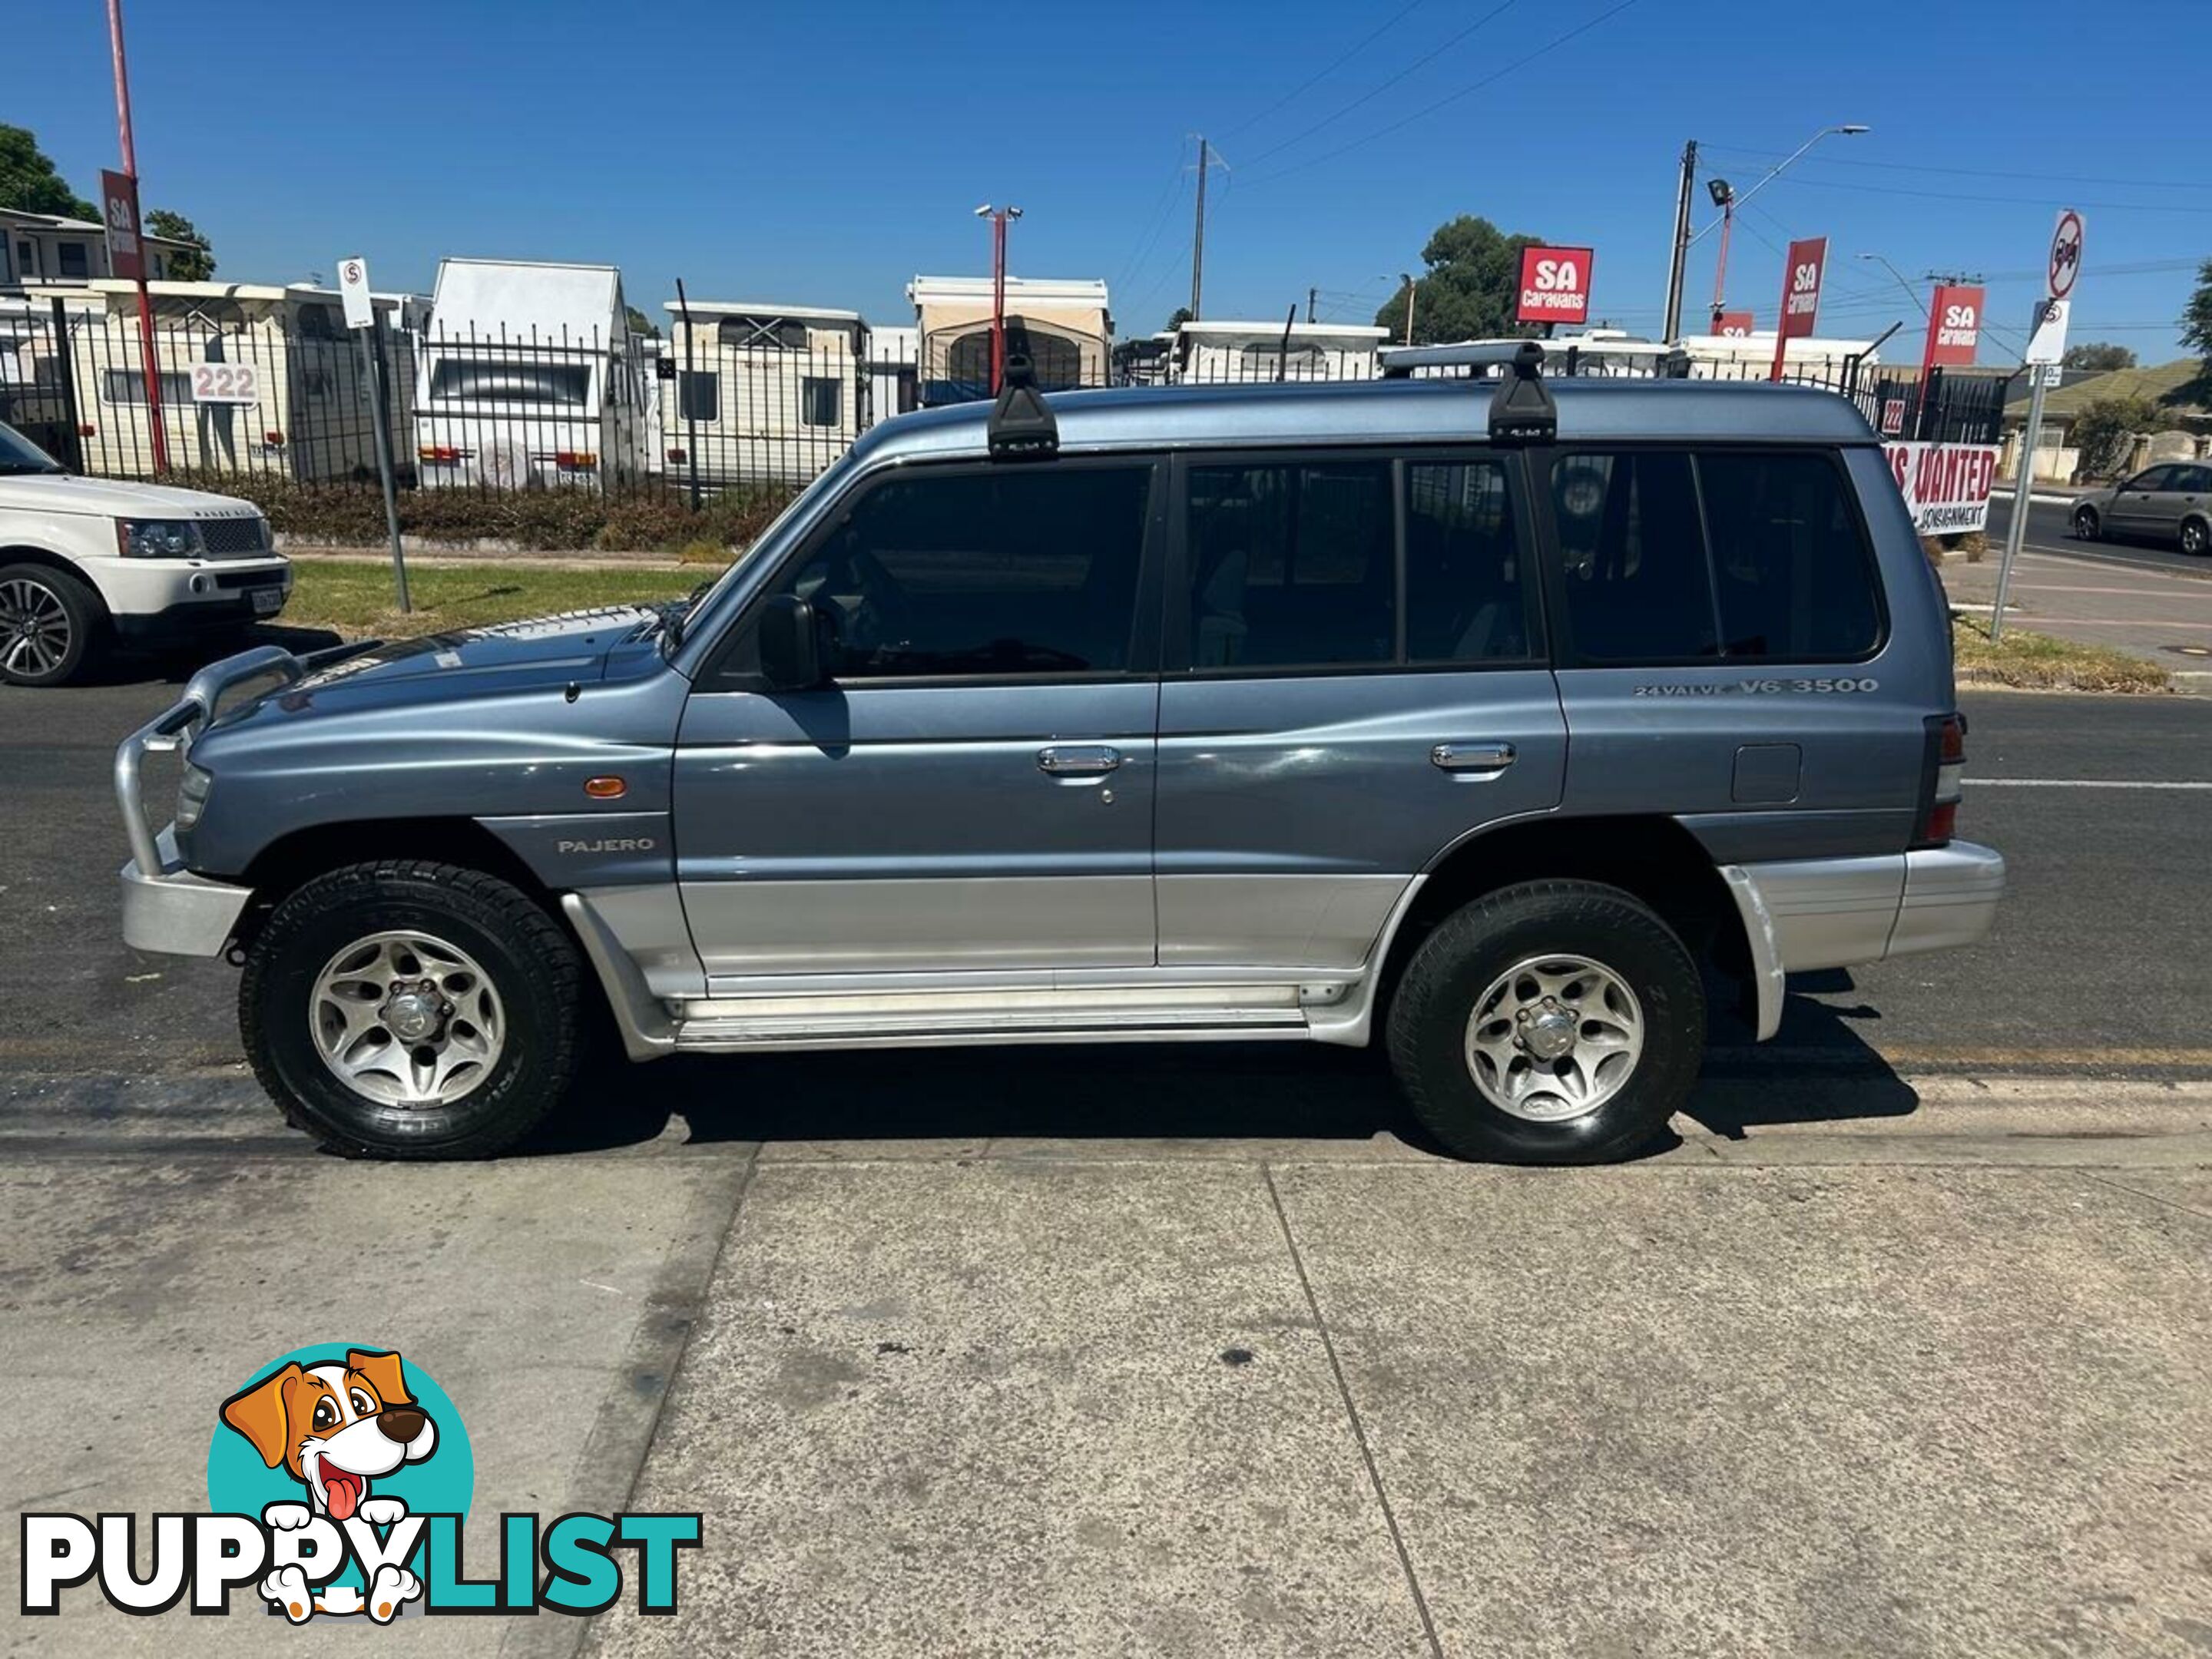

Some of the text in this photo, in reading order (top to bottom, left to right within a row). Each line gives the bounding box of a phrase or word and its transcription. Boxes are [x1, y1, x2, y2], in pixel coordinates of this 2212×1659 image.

[110, 197, 132, 229] SA
[1536, 260, 1577, 290] SA
[1794, 263, 1816, 291] SA
[1522, 290, 1584, 310] Caravans
[1945, 305, 1974, 328] SA
[196, 366, 256, 397] 222
[1883, 402, 1903, 431] 222
[1914, 448, 1995, 503] WANTED
[1739, 680, 1781, 694] V6
[1793, 678, 1879, 693] 3500
[558, 838, 654, 853] PAJERO
